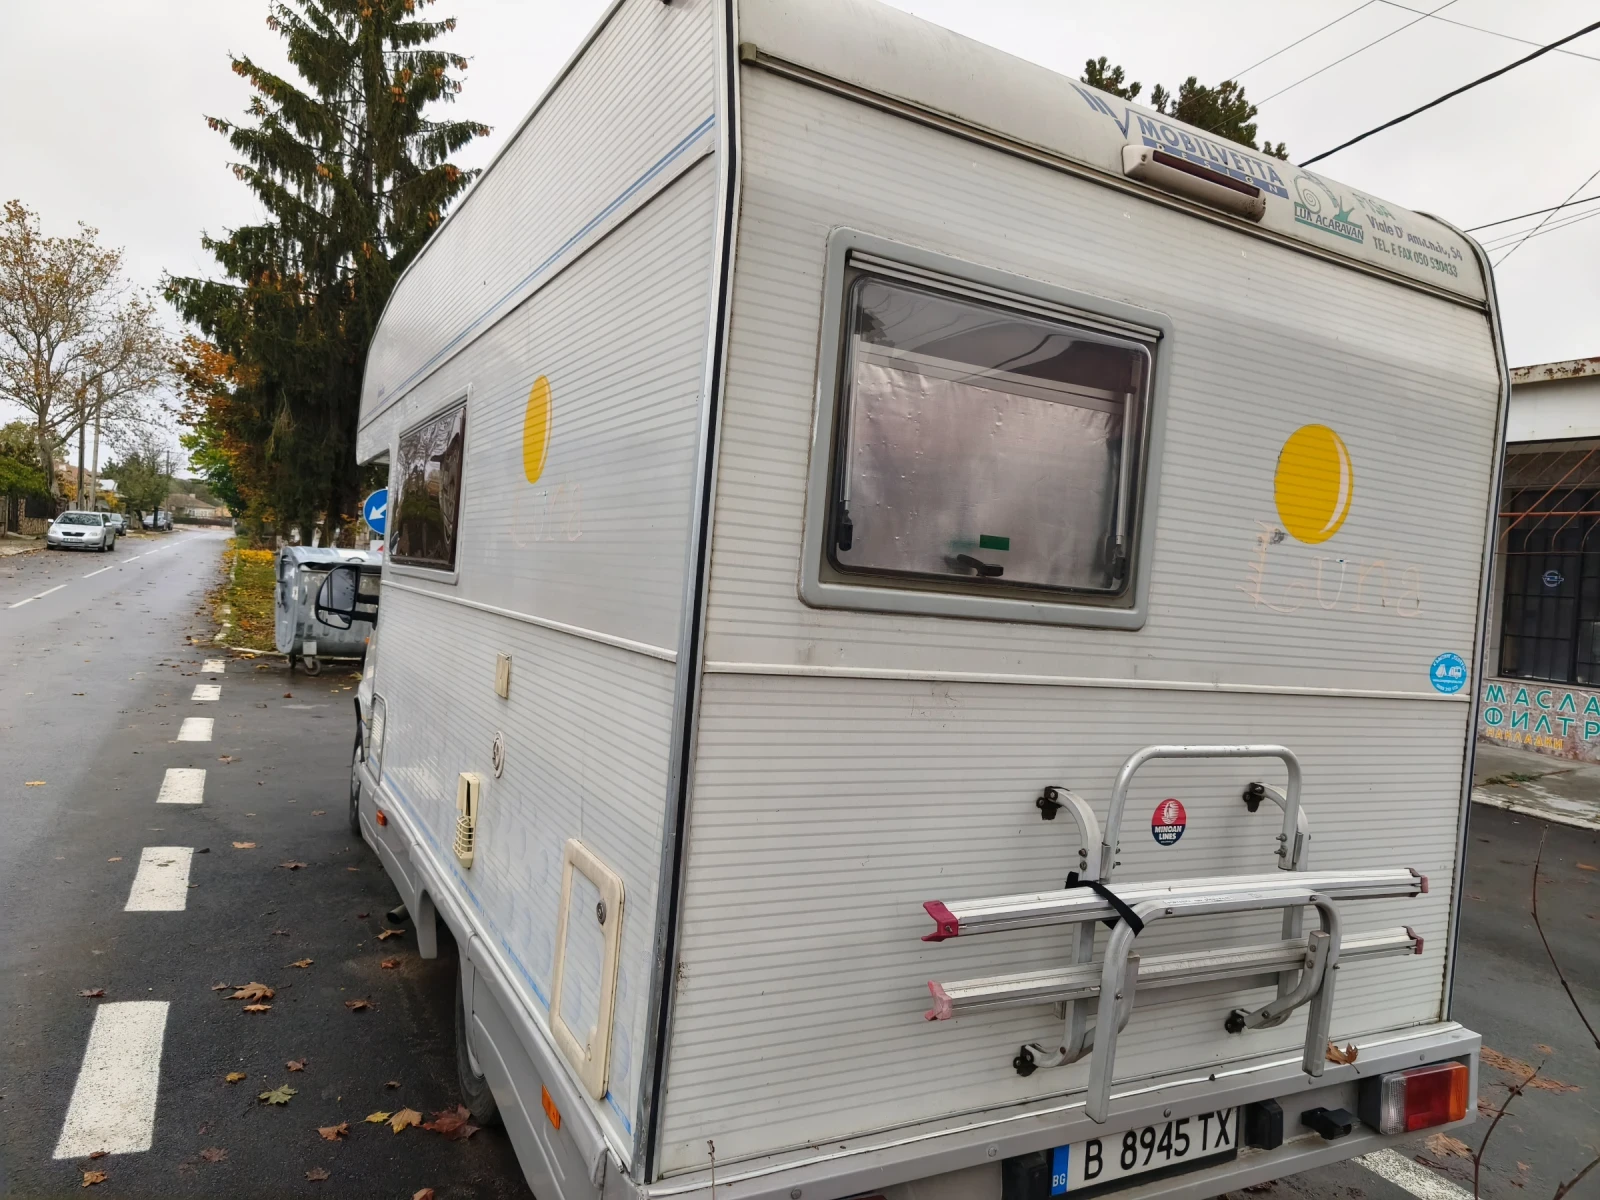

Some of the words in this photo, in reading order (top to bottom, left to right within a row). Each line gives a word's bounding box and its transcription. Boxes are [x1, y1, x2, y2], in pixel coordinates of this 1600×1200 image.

[1136, 115, 1285, 187] MOBILVETTA
[1366, 214, 1394, 236] Viale
[1372, 236, 1390, 254] TEL.
[1390, 243, 1397, 256] E
[1397, 245, 1413, 262] FAX
[1413, 251, 1429, 267] 050
[1484, 683, 1600, 717] МАСЛА
[1484, 706, 1600, 741] ФИЛТР
[1486, 726, 1563, 750] НАКЛАДКИ
[1154, 825, 1182, 833] MINOAN
[1084, 1139, 1104, 1181] B
[1120, 1117, 1190, 1171] 8945
[1197, 1107, 1232, 1151] TX
[1052, 1172, 1067, 1188] BG
